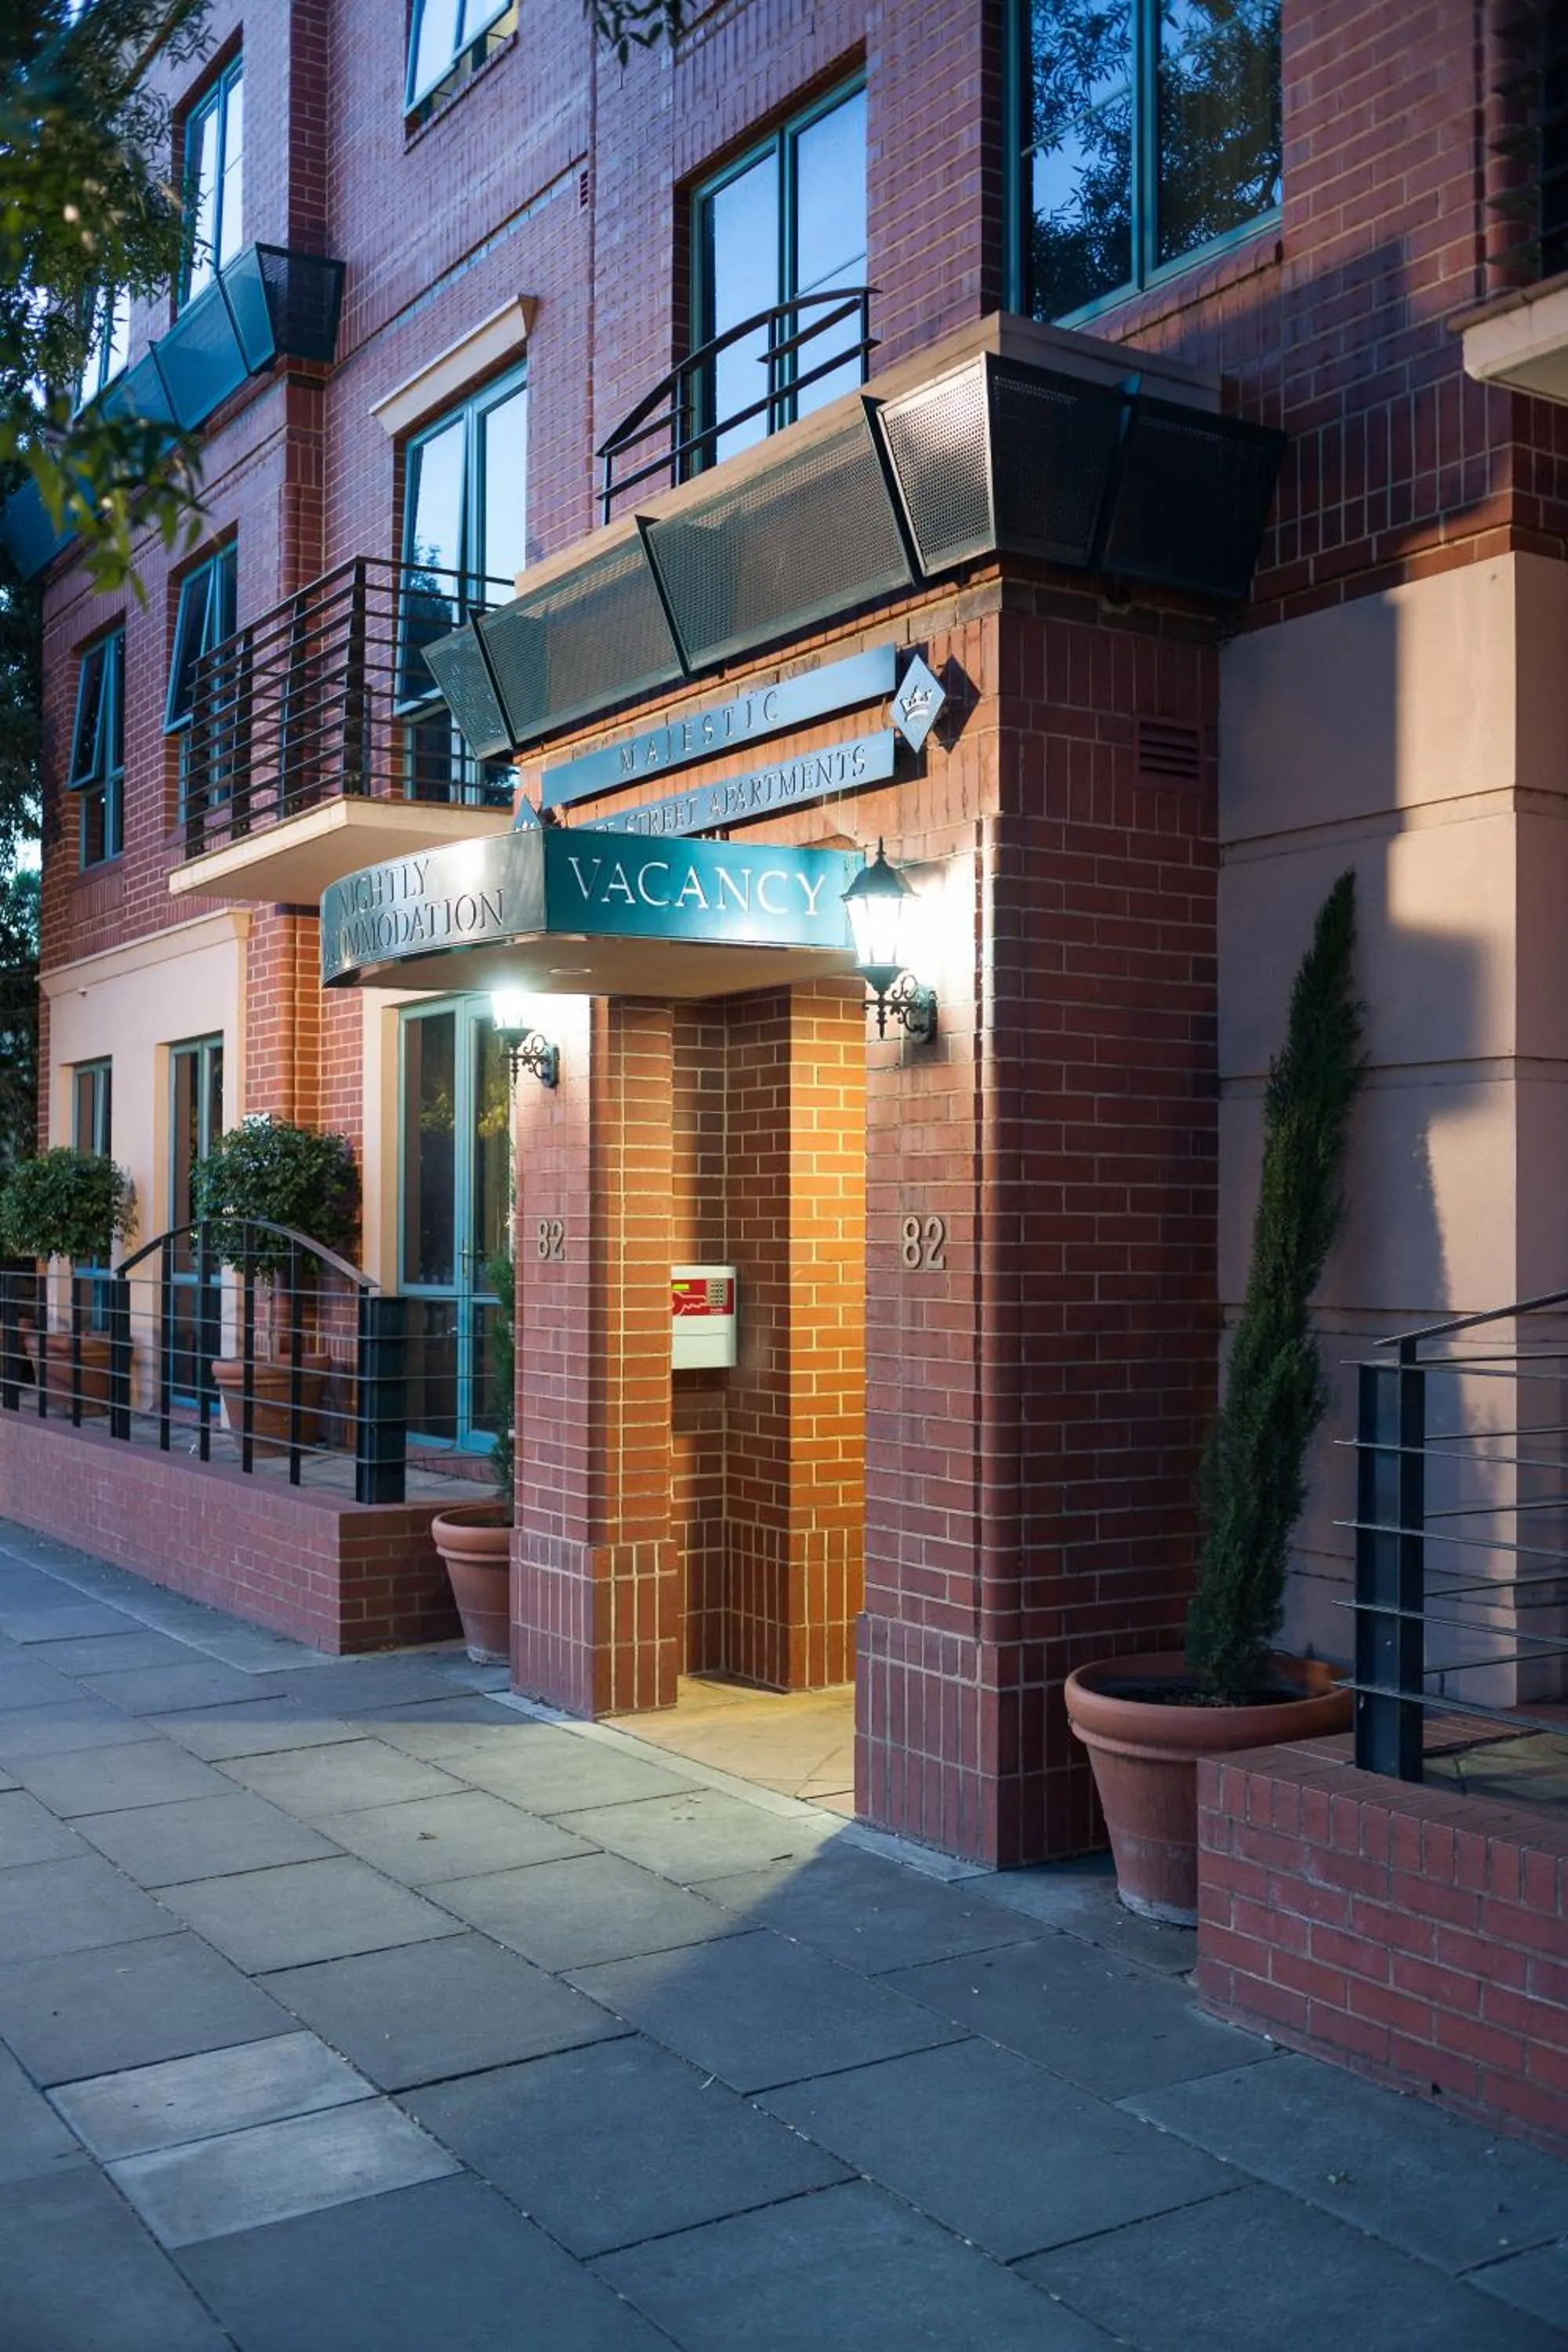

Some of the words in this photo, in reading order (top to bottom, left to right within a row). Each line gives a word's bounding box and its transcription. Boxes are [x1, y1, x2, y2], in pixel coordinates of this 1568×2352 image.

[620, 690, 779, 774] MAJESTIC
[625, 797, 698, 837] STREET
[708, 746, 866, 819] APARTMENTS
[339, 858, 429, 920] NIGHTLY
[568, 856, 826, 916] VACANCY
[537, 1218, 564, 1261] 82
[902, 1216, 946, 1270] 82
